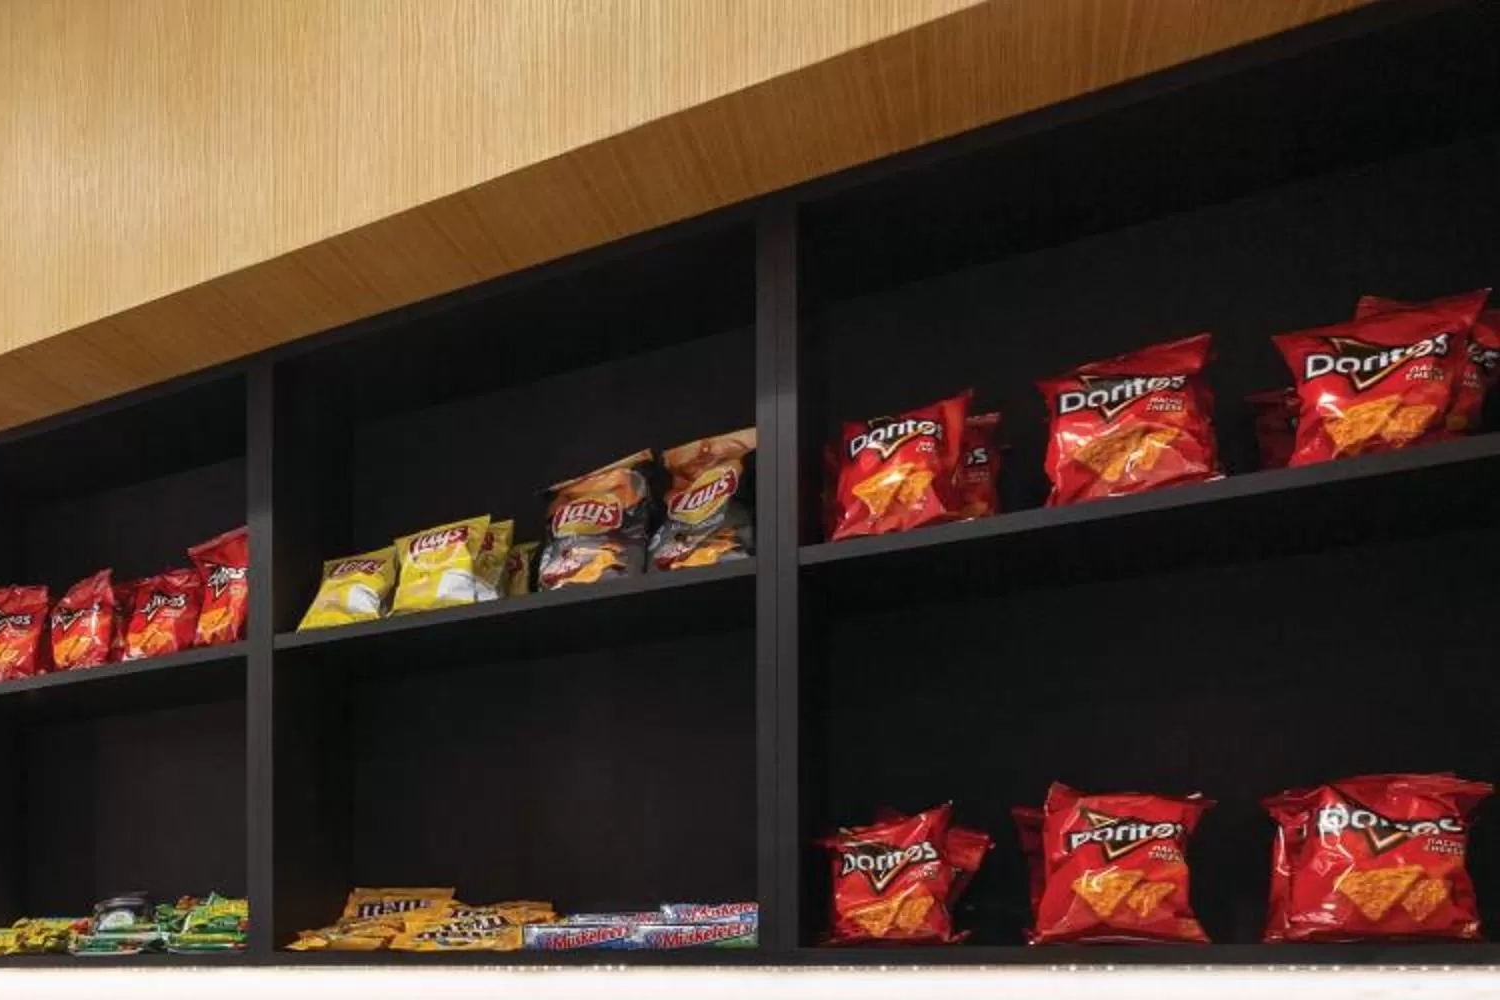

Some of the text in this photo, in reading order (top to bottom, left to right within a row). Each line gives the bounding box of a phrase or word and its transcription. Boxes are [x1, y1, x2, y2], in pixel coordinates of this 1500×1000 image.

[1305, 333, 1449, 379] Doritos
[1059, 375, 1186, 414] Doritos
[841, 841, 938, 876] Doritos
